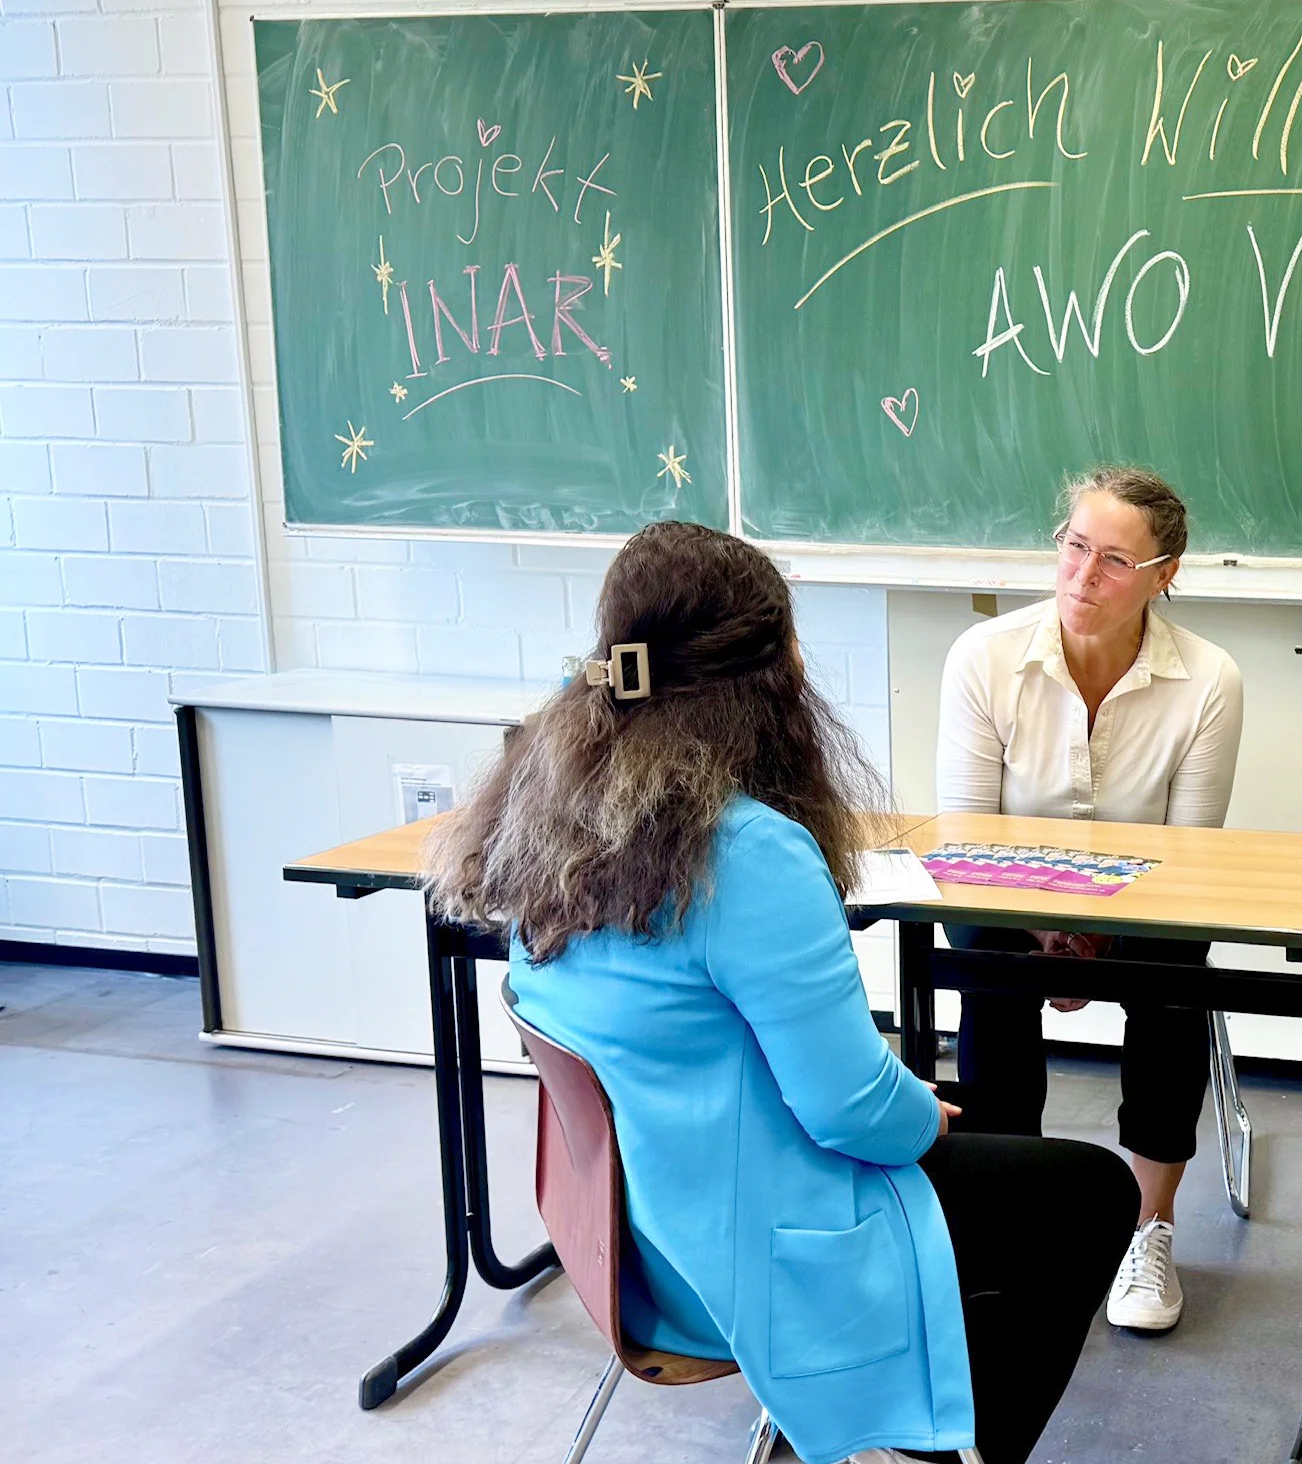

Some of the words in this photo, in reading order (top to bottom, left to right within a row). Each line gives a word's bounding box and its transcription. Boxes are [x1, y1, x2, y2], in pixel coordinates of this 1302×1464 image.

[357, 118, 618, 245] Projekt
[758, 56, 1088, 246] Herzlich
[972, 228, 1192, 378] AWO
